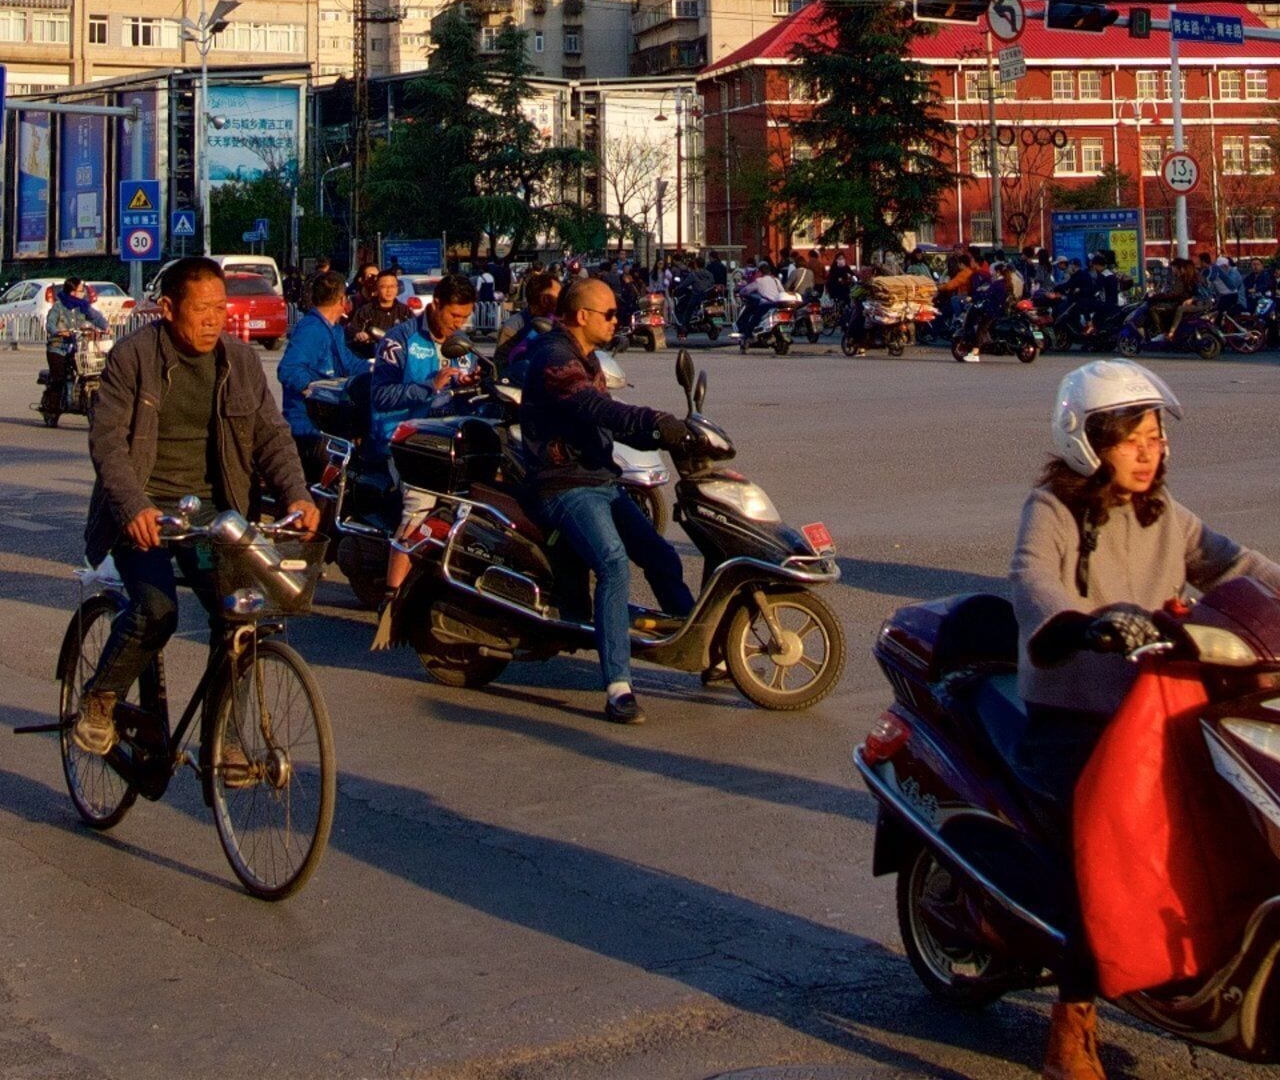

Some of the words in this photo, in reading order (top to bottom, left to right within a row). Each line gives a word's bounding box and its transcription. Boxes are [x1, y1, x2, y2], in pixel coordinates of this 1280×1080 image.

[1174, 18, 1200, 36] 青年路
[1216, 22, 1242, 38] 青年路
[123, 214, 158, 225] 地铁施工
[133, 236, 148, 248] 30
